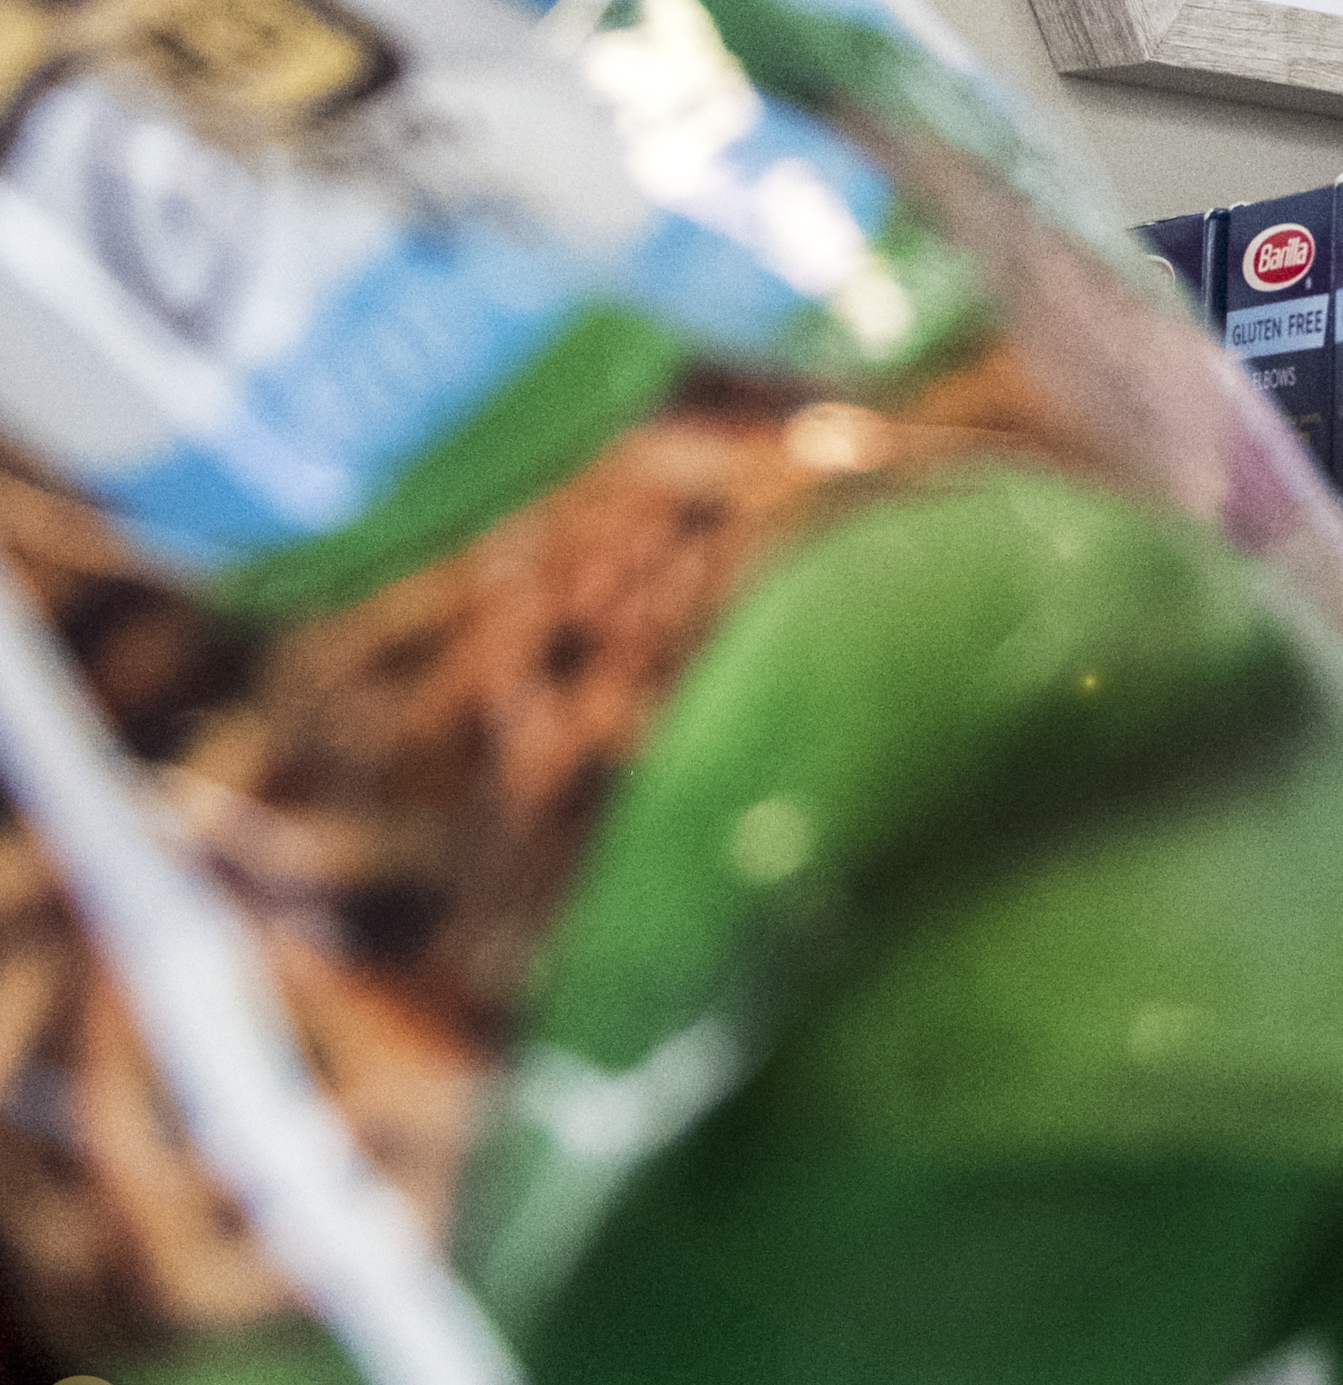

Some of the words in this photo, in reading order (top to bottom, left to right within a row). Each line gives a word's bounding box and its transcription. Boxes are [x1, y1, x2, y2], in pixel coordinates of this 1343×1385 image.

[1257, 236, 1309, 274] Barilla
[1232, 318, 1282, 347] GLUTEN
[1288, 309, 1323, 336] FREE
